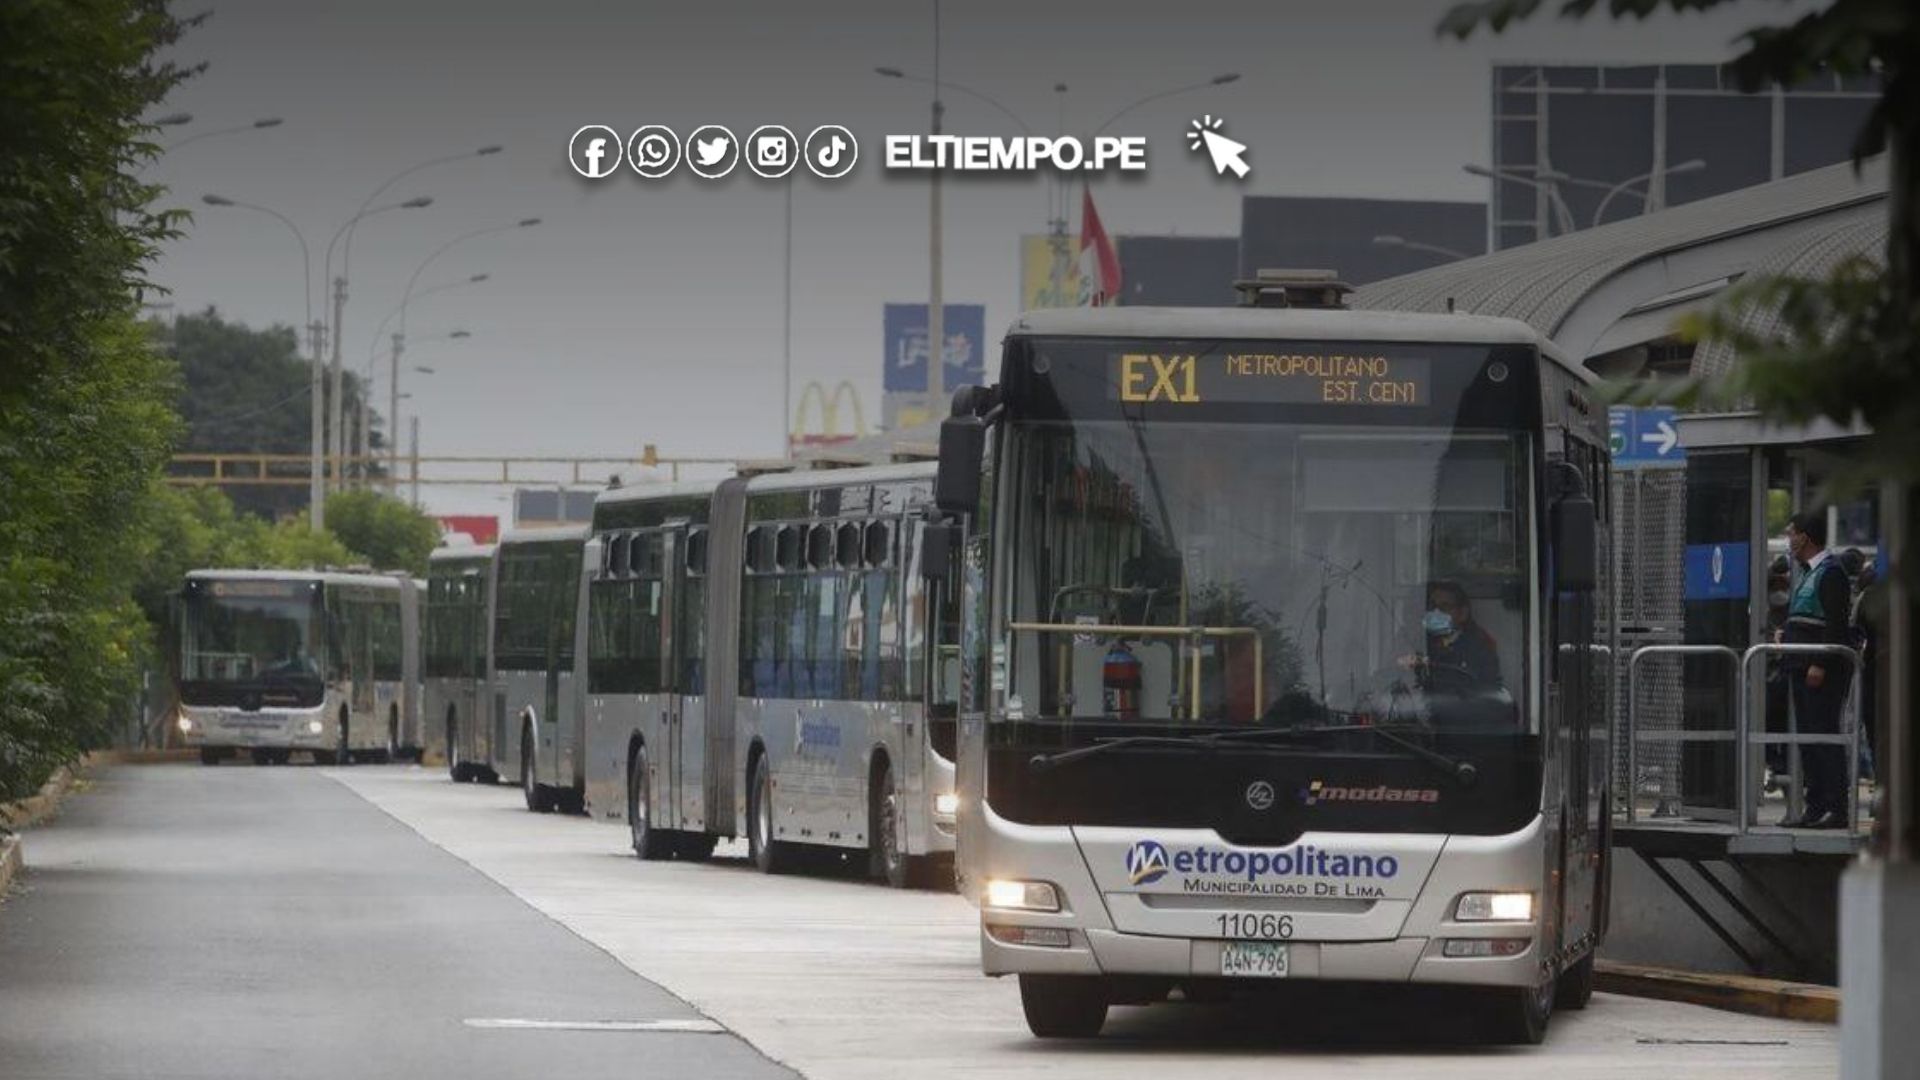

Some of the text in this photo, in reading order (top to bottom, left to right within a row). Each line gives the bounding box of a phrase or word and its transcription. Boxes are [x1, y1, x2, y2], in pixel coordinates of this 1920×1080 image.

[1227, 355, 1388, 376] METROPOLITANO
[1121, 355, 1199, 402] EX1
[1323, 380, 1364, 401] EST.
[1318, 785, 1438, 802] modasa
[1217, 913, 1293, 938] 11066
